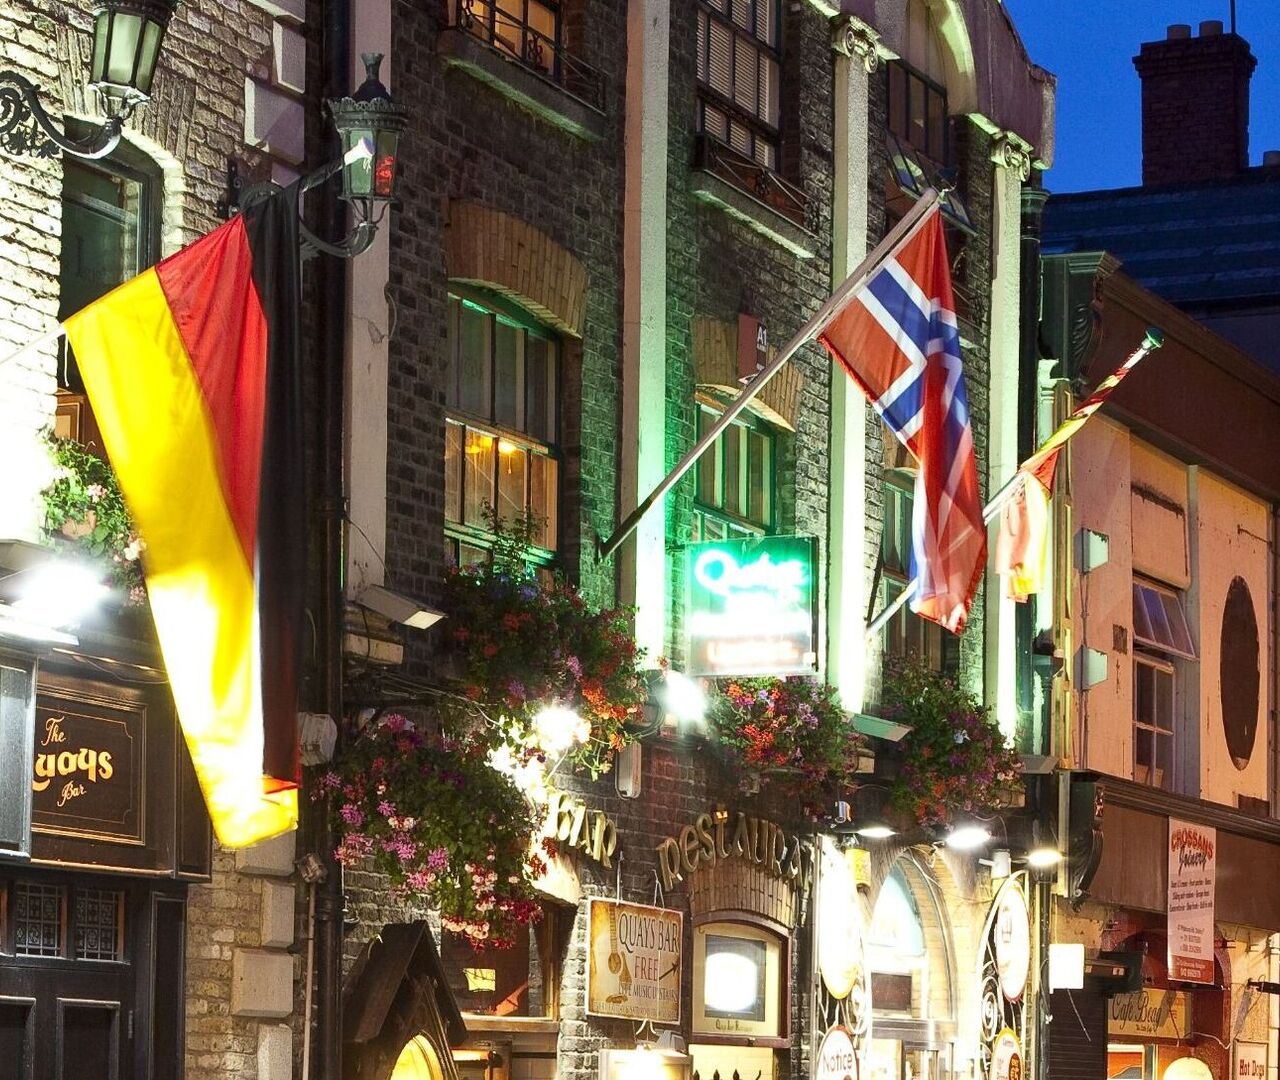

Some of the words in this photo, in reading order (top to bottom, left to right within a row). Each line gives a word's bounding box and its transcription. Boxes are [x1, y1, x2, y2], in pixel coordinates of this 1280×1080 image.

[41, 715, 67, 746] The
[57, 780, 87, 807] Bar
[619, 913, 656, 954] QUAYS
[657, 919, 679, 953] BAR
[634, 956, 658, 981] FREE
[633, 984, 652, 999] MUSIC
[822, 1049, 853, 1073] Notice
[1239, 1059, 1250, 1076] Hot
[1251, 1060, 1265, 1079] Dogs
